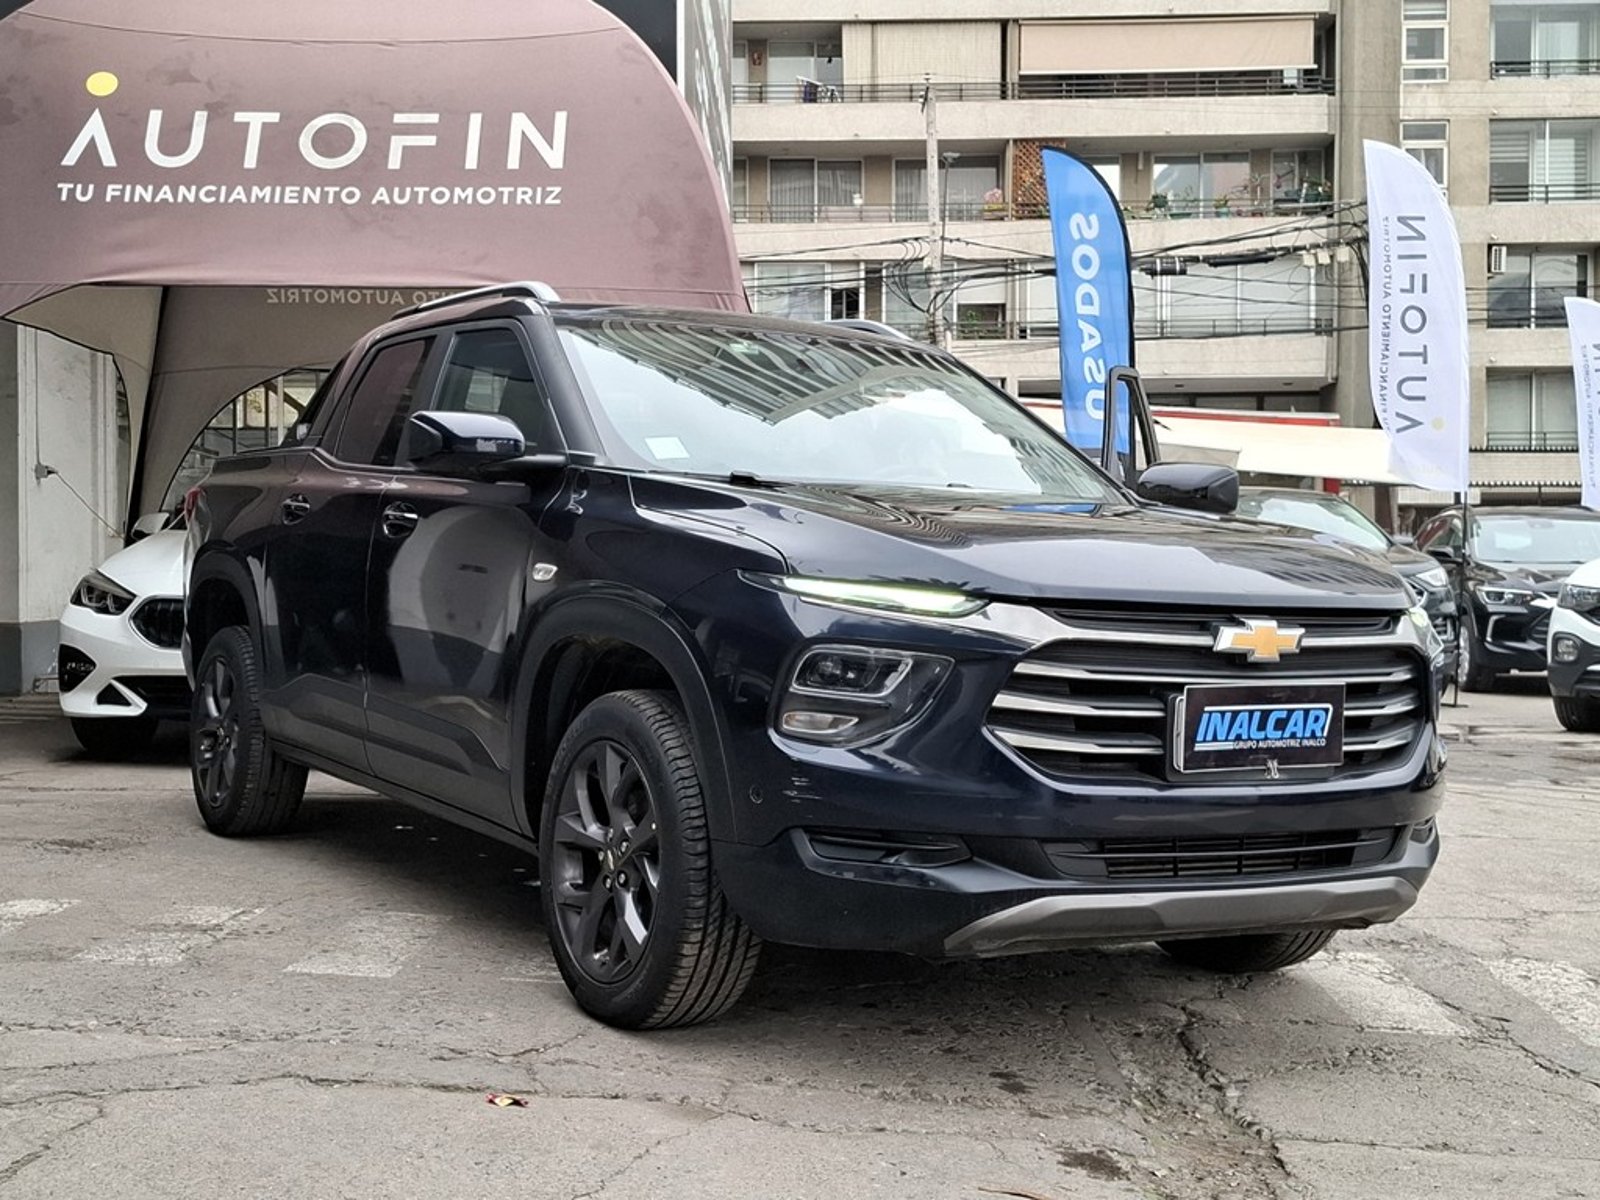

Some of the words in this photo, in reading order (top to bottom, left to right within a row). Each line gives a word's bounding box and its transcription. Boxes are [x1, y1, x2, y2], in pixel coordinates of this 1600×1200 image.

[60, 107, 568, 170] AUTOFIN
[57, 183, 94, 202] TU
[105, 184, 361, 205] FINANCIAMIENTO
[371, 186, 562, 205] AUTOMOTRIZ
[1196, 709, 1327, 742] INALCAR
[1233, 739, 1257, 750] GRUPO
[1258, 738, 1300, 749] AUTOMOTRIZ
